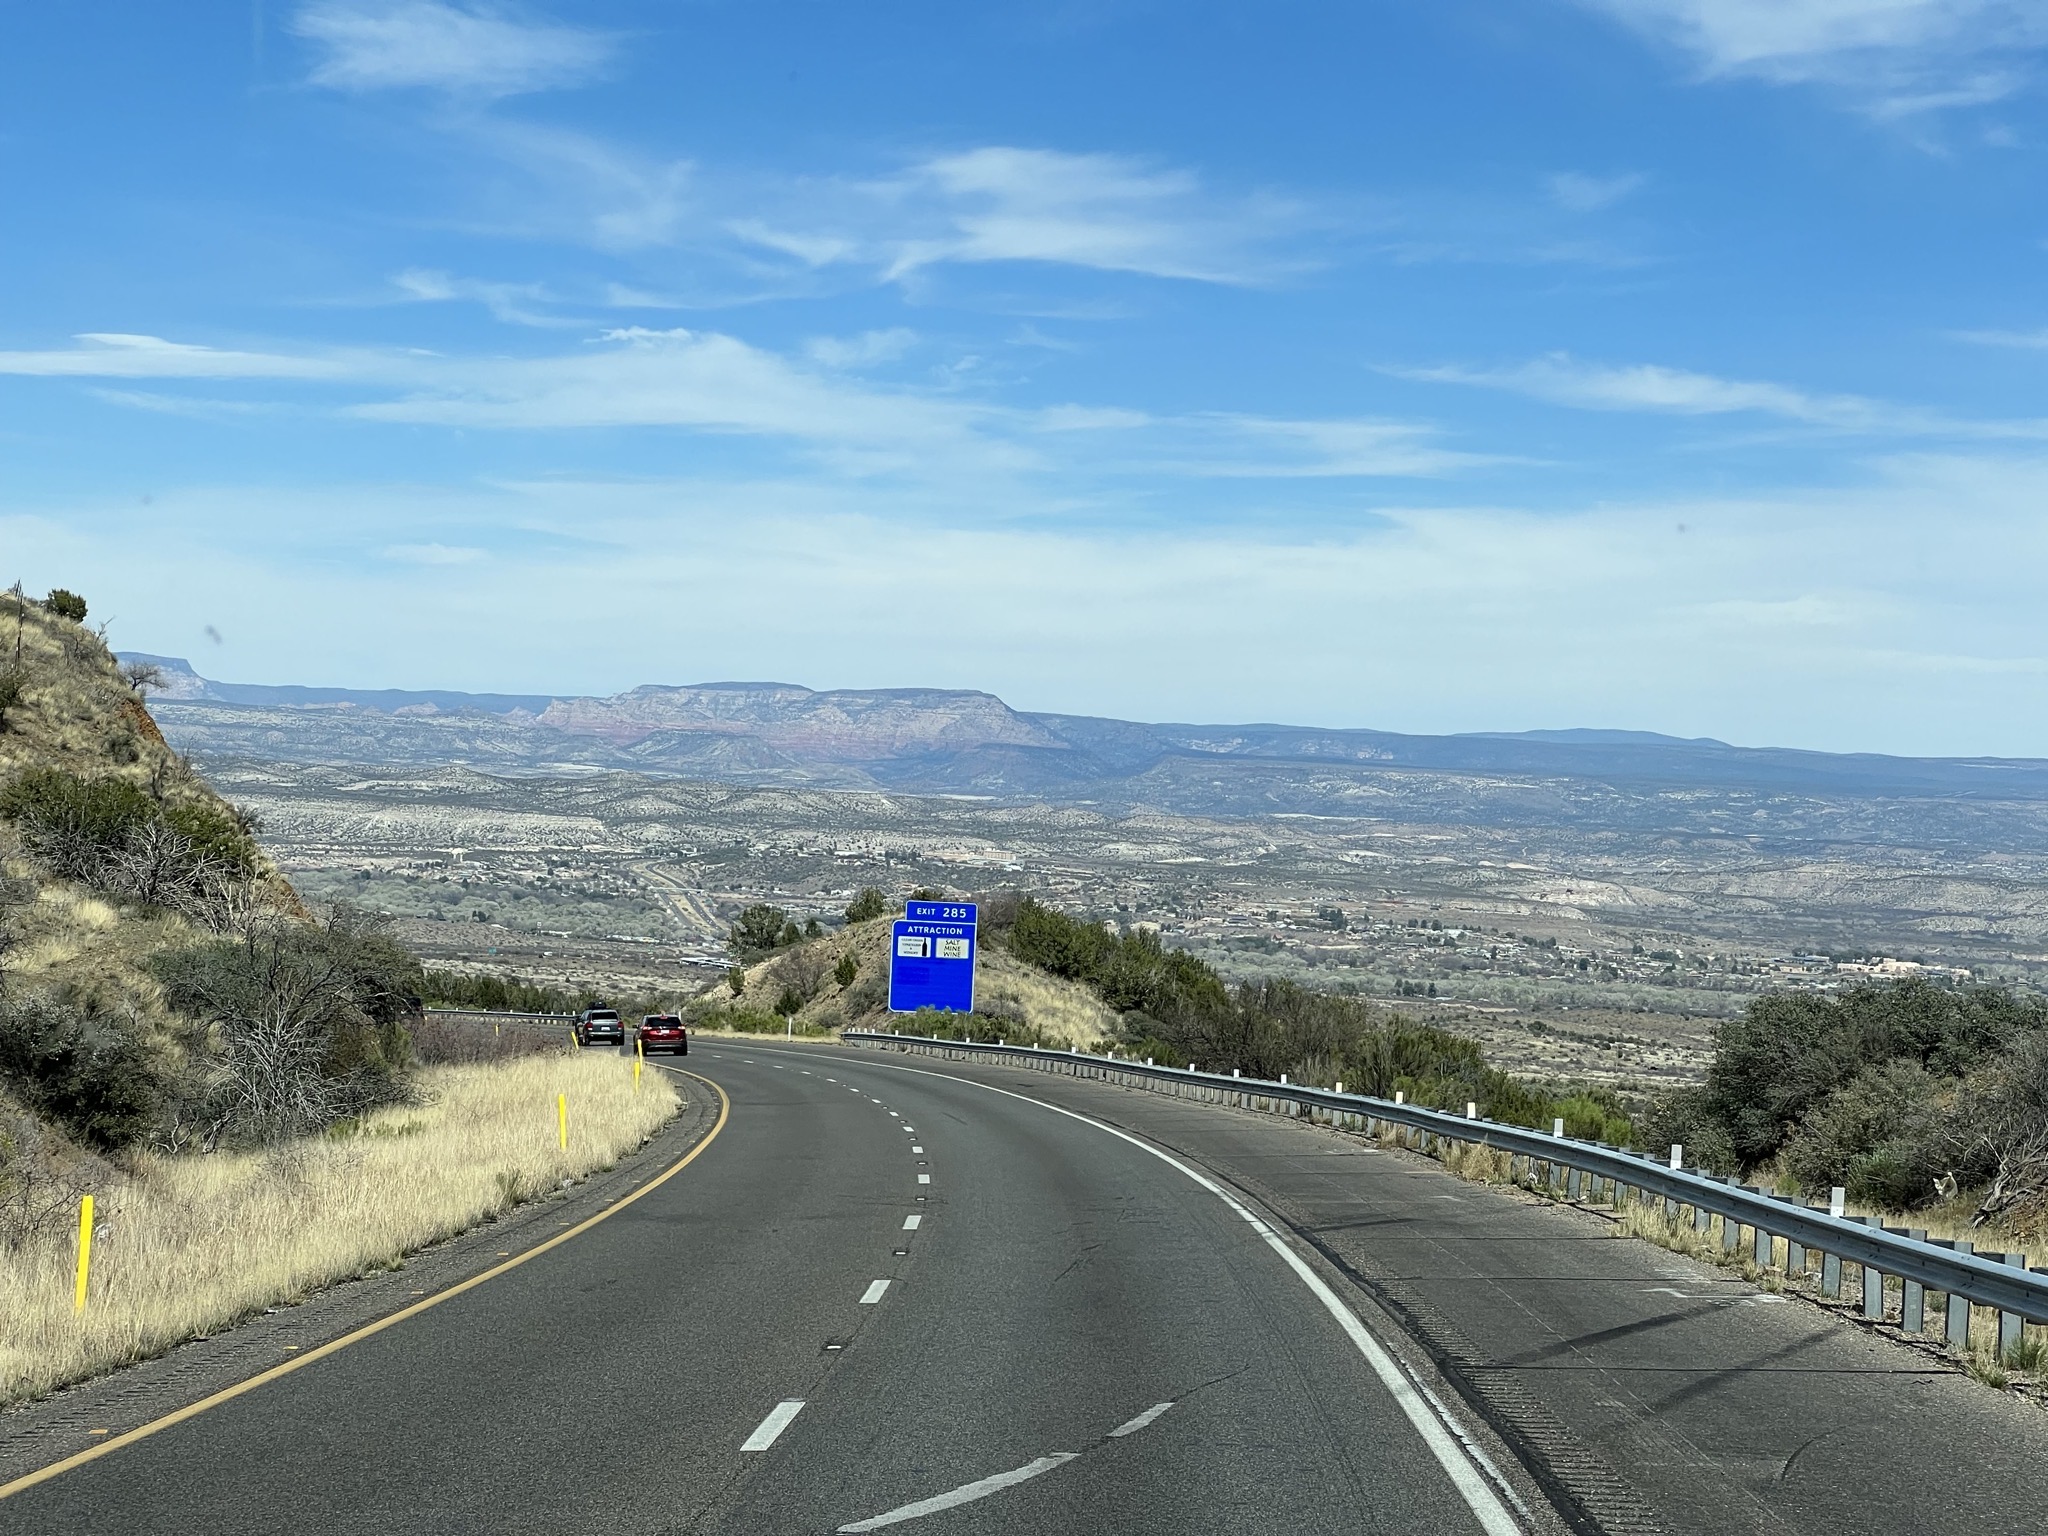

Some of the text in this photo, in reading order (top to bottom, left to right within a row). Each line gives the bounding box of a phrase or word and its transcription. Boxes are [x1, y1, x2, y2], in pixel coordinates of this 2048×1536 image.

[917, 908, 966, 918] EXIT 285
[908, 926, 963, 934] ATTRACTION
